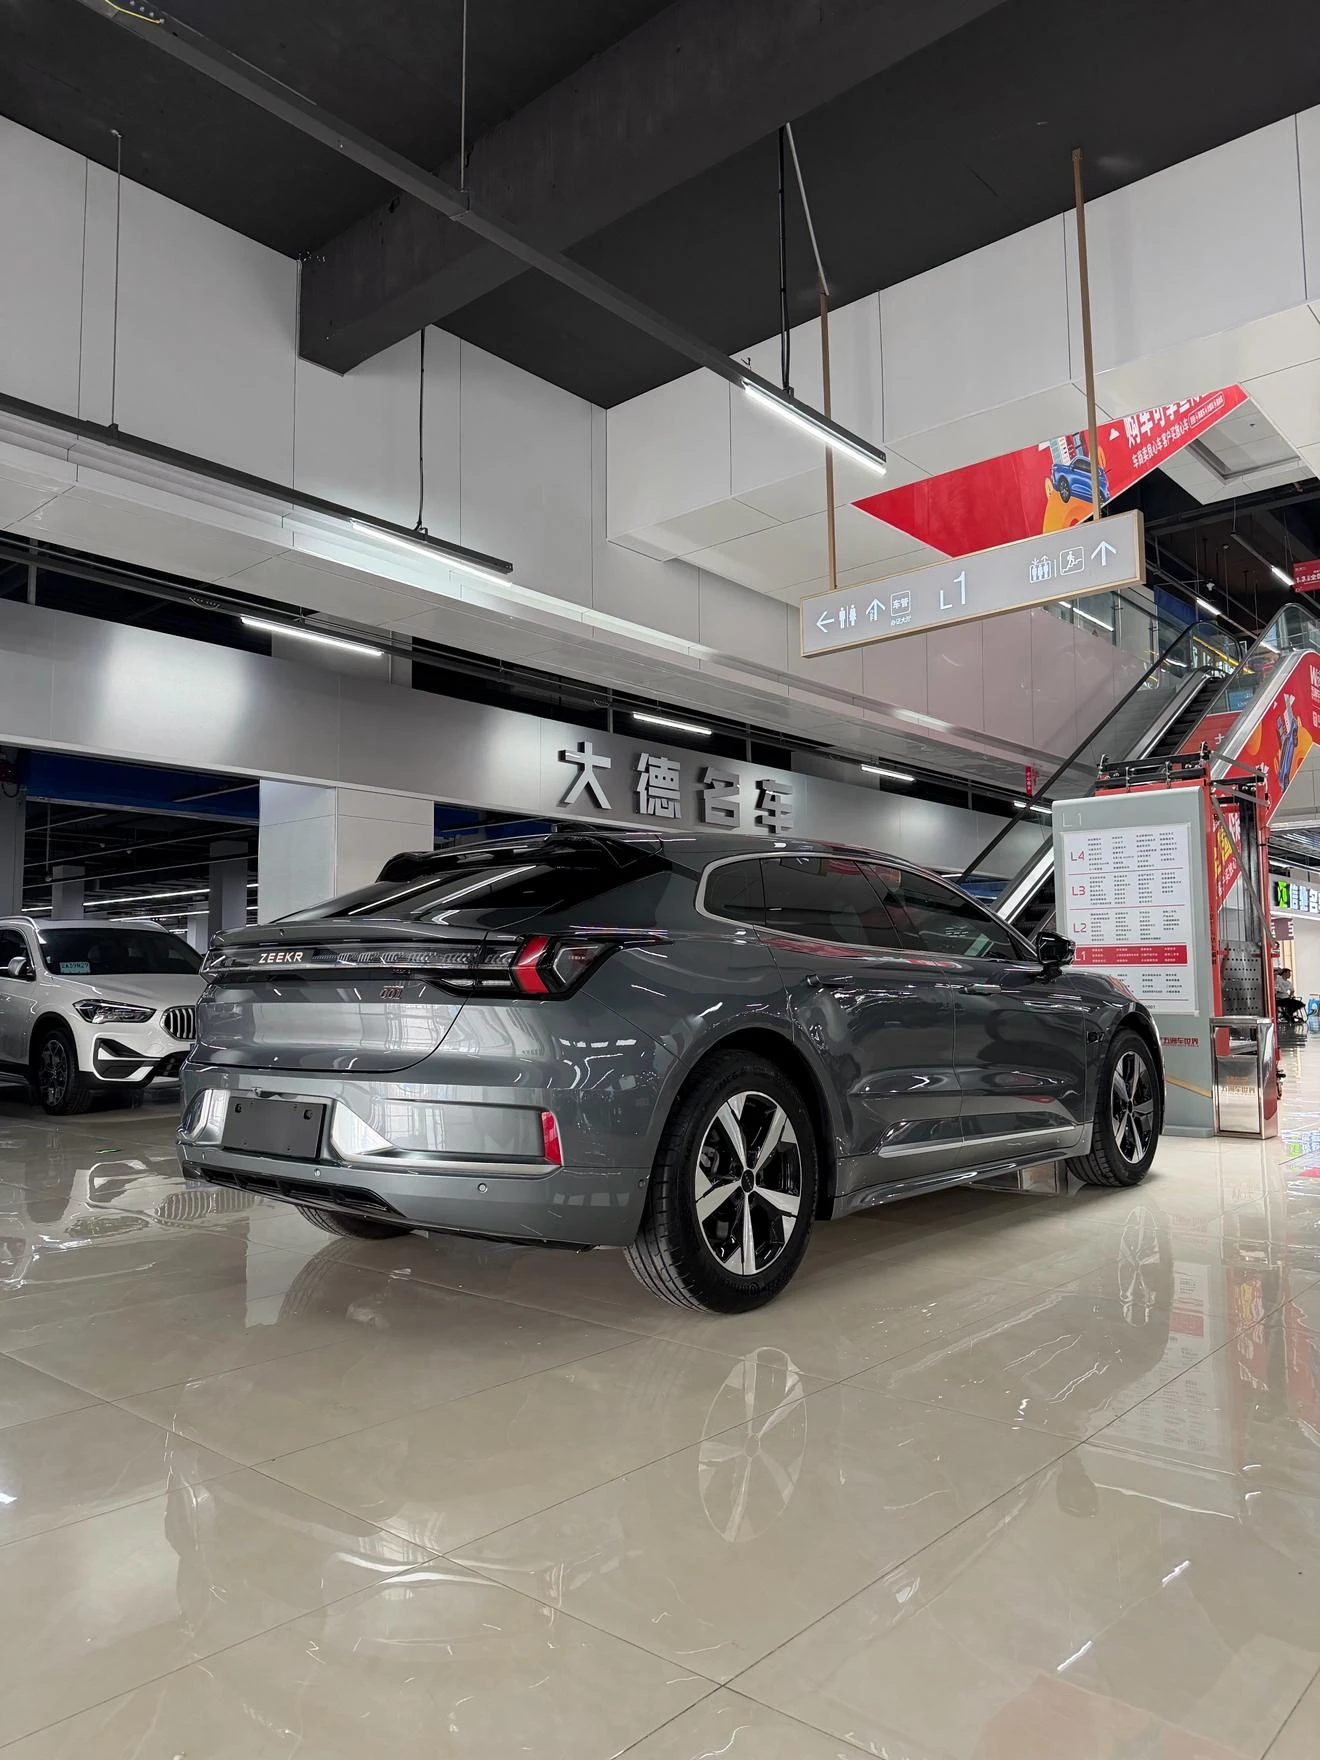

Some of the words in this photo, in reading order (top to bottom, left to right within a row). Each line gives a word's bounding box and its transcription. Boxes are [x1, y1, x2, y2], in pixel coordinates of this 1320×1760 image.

[939, 570, 966, 610] L1
[892, 597, 909, 610] 车管
[557, 740, 797, 835] 大德名车
[1062, 811, 1082, 828] L1
[1070, 850, 1085, 862] L4
[1071, 885, 1086, 897] L3
[1073, 922, 1087, 934] L2
[258, 951, 304, 964] ZEEKR
[1074, 950, 1087, 961] L1
